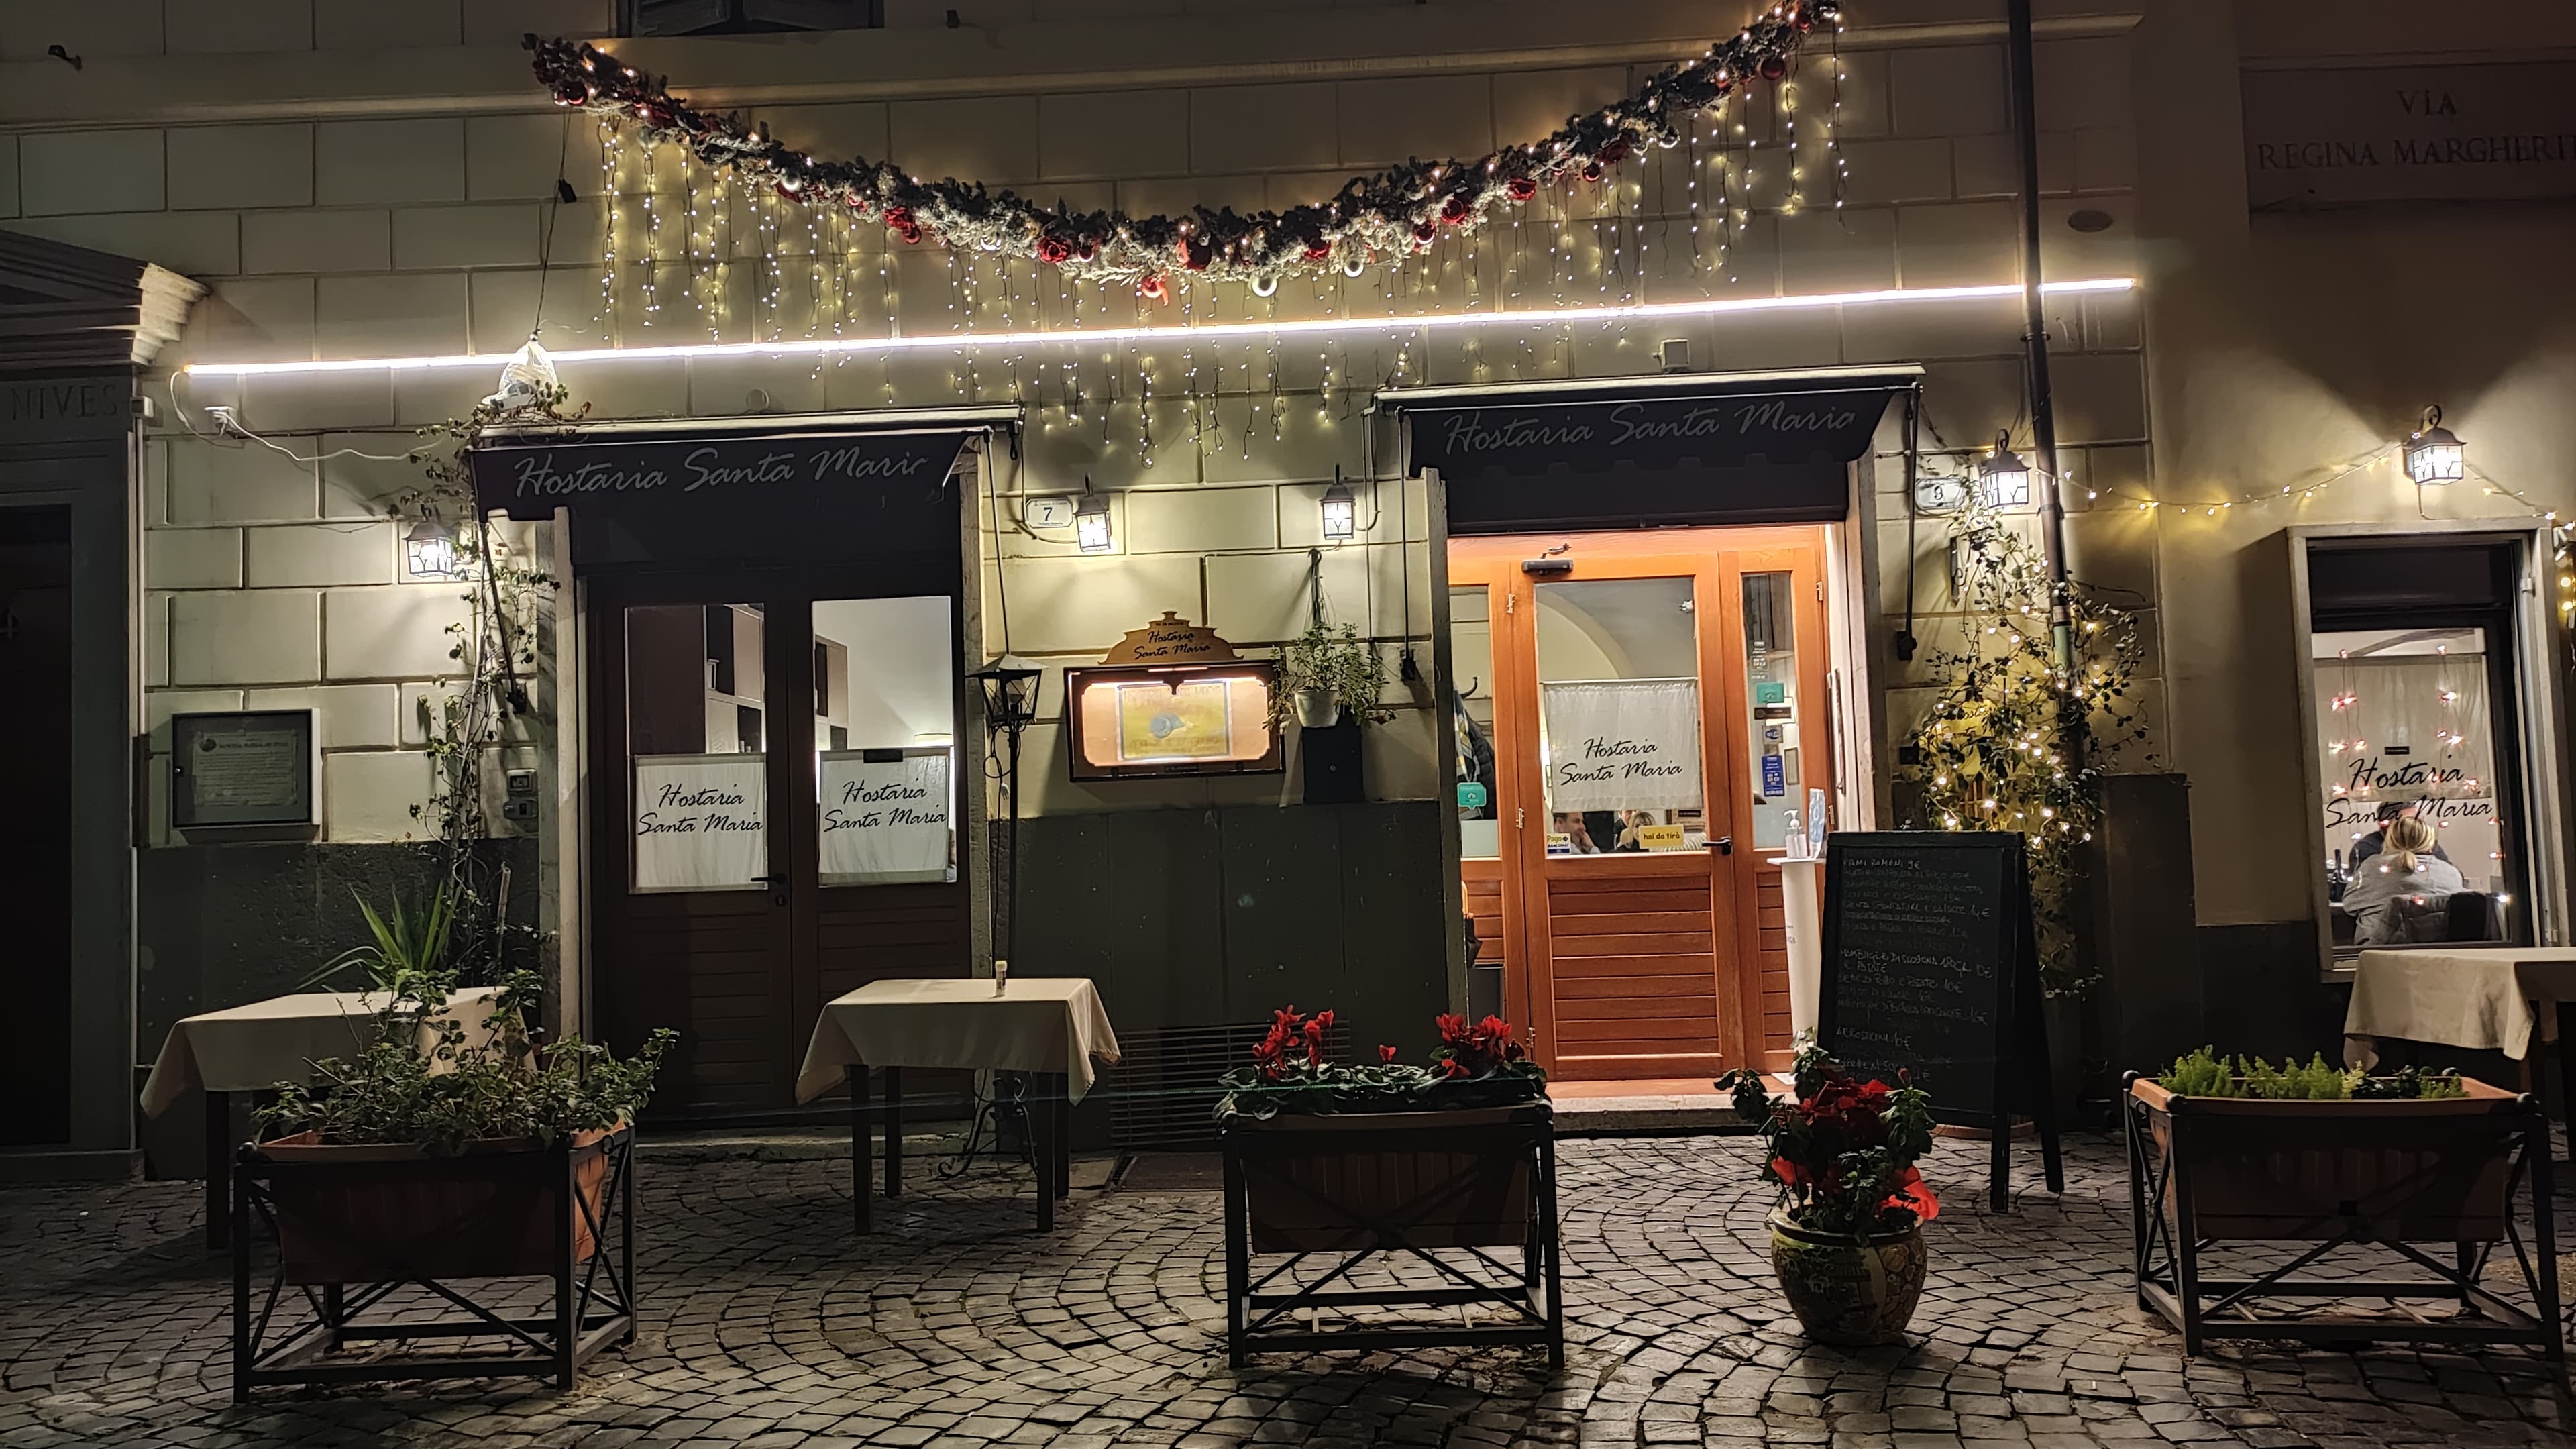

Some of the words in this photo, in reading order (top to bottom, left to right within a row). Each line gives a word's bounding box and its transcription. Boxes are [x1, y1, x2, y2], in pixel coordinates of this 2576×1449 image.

[2397, 89, 2457, 116] VIA
[2257, 141, 2379, 170] REGINA
[10, 384, 118, 421] NIVES
[1443, 412, 1594, 455] Hostaria
[1610, 403, 1721, 445] Santa
[1734, 400, 1856, 433] Maria
[514, 454, 668, 497] Hostaria
[683, 447, 795, 492] Santa
[1934, 485, 1943, 500] 9
[1044, 506, 1053, 521] 7
[1148, 629, 1195, 644] Hostaria
[1134, 645, 1169, 660] Santa
[1172, 642, 1212, 655] Maria
[1584, 735, 1658, 759] Hostaria
[1560, 762, 1614, 786] Santa
[1620, 760, 1684, 779] Maria
[2349, 754, 2465, 791] Hostaria
[659, 782, 745, 808] Hostaria
[842, 777, 928, 804] Hostaria
[824, 808, 881, 833] Santa
[888, 804, 947, 828] Maria
[2326, 797, 2404, 829] Santa
[2415, 790, 2493, 819] Maria
[637, 812, 698, 836] Santa
[703, 812, 763, 833] Maria
